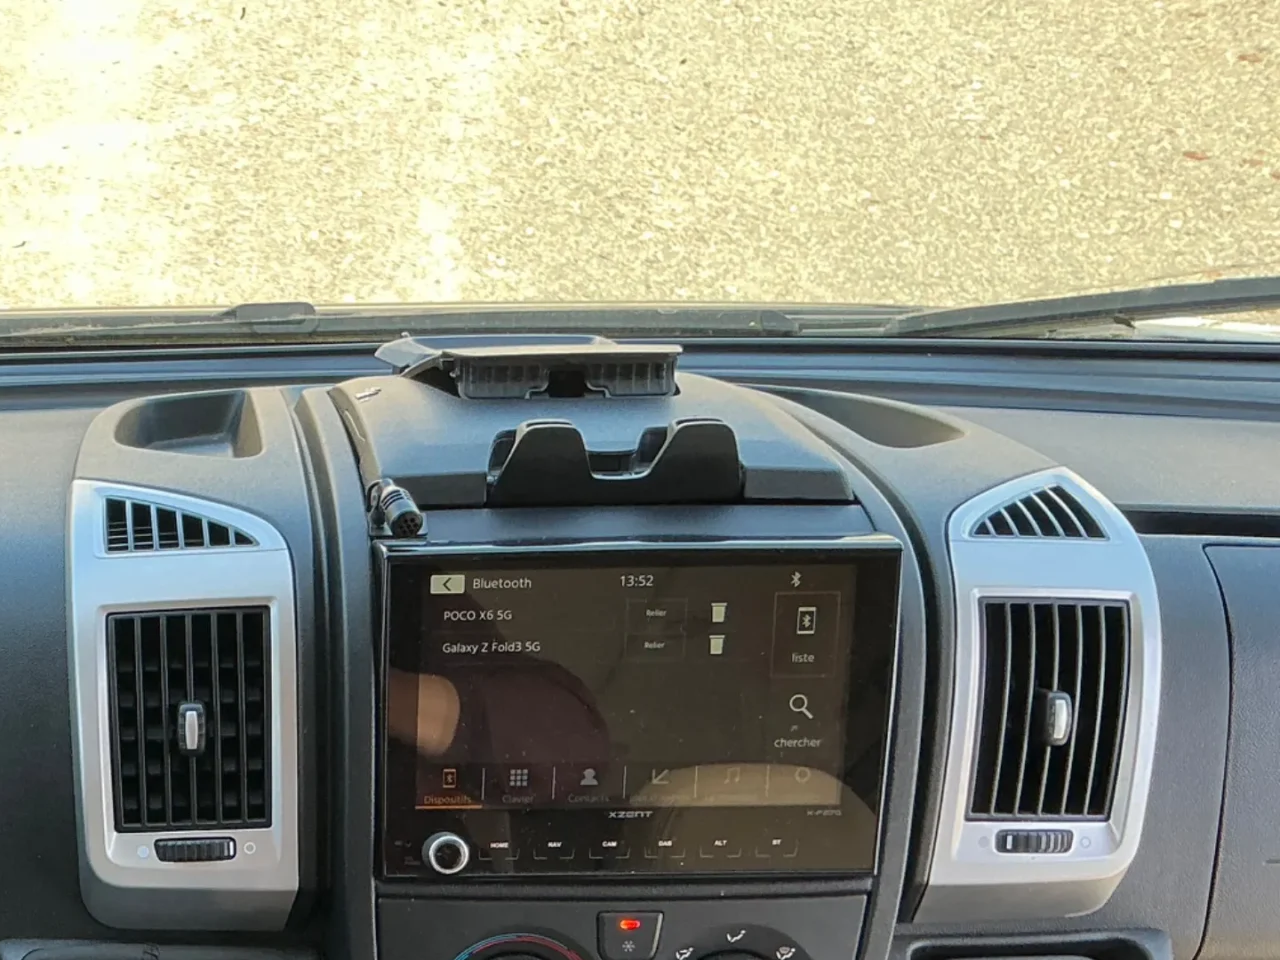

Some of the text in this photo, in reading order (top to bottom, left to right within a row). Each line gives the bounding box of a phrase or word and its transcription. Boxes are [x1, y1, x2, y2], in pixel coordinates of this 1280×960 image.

[472, 574, 654, 590] Bluetooth 13:52
[443, 610, 512, 621] POCO X6 5G
[646, 609, 667, 617] Relier
[442, 641, 541, 655] Galaxy Z Fold3 5G
[644, 641, 665, 649] Relier
[791, 652, 815, 663] liste
[774, 737, 822, 748] chercher
[490, 841, 510, 849] HOME
[602, 840, 618, 848] CAM
